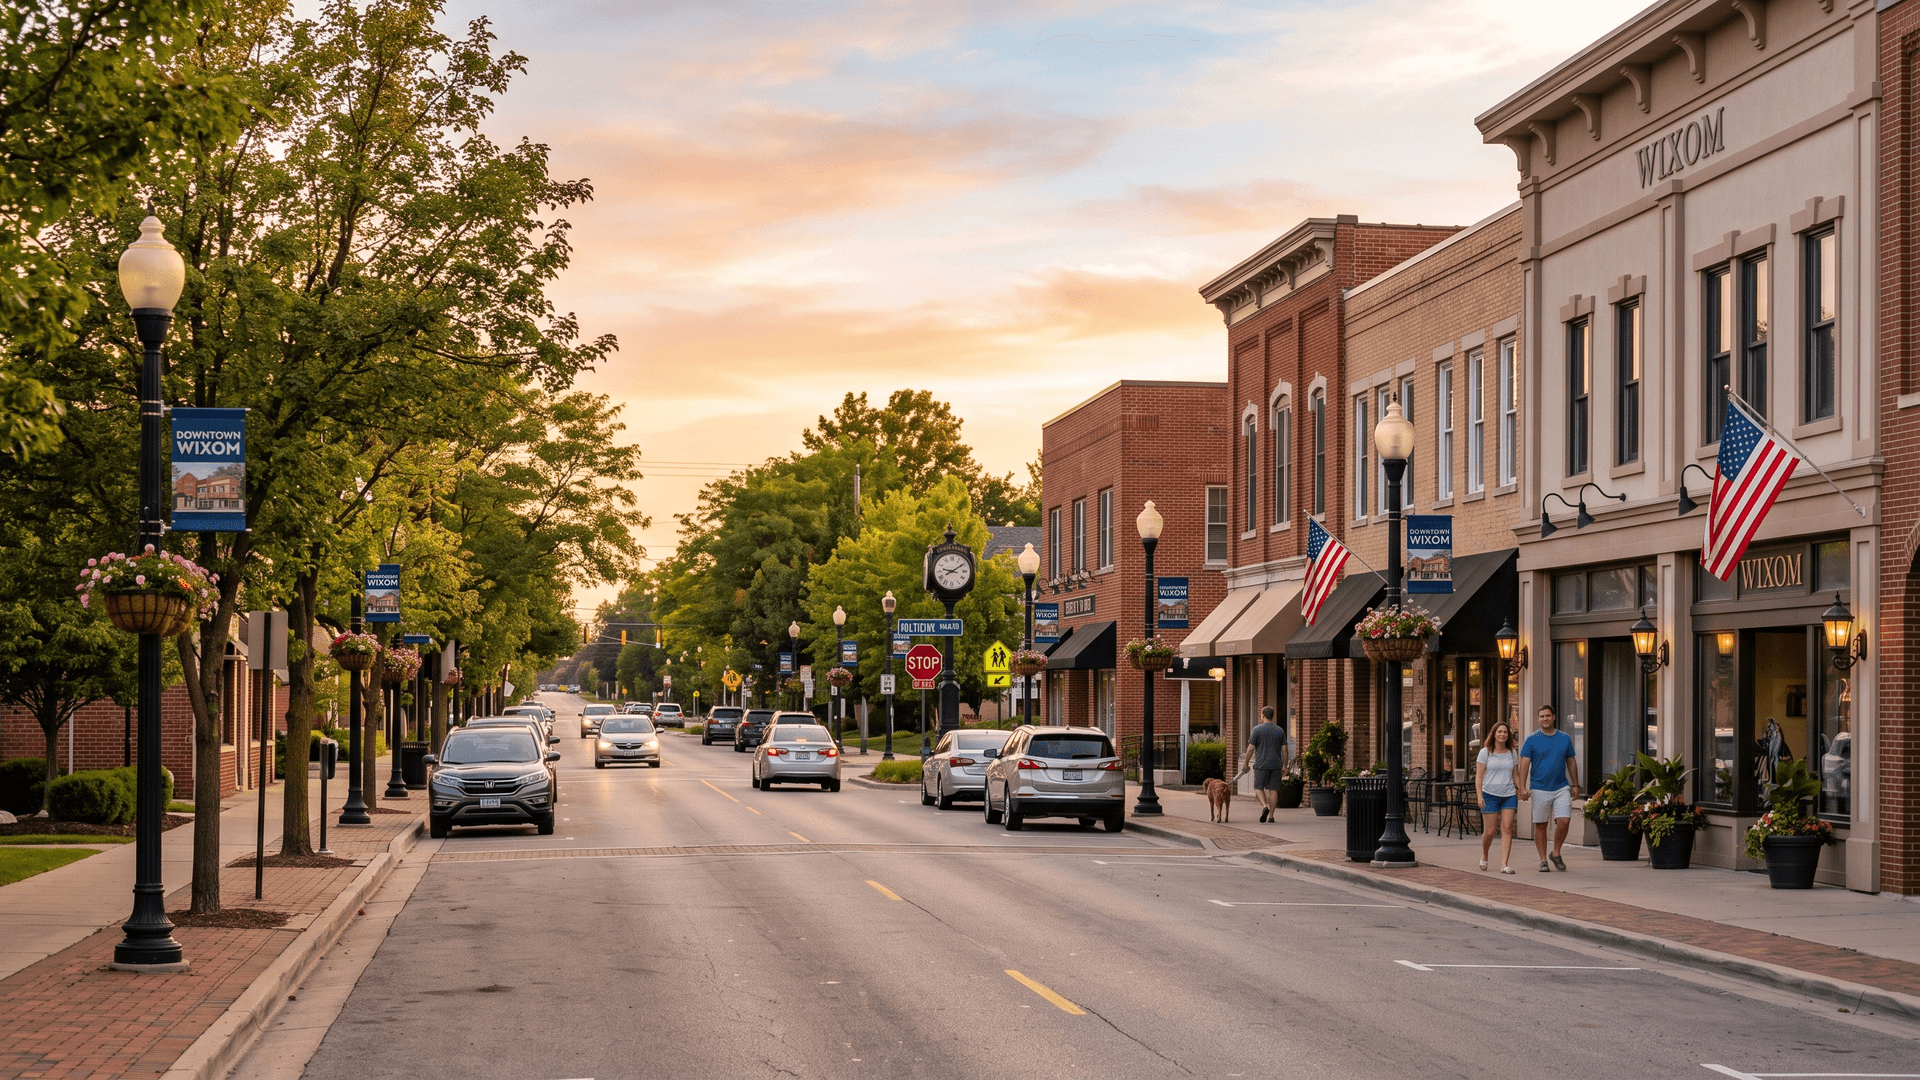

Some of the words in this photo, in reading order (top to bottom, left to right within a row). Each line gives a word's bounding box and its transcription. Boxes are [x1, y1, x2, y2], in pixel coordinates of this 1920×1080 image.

[1635, 106, 1725, 189] WIXOM
[176, 430, 241, 440] DOWNTOWN
[176, 441, 240, 455] WIXOM
[1409, 535, 1450, 545] WIXOM
[1740, 553, 1803, 590] WIXOM
[367, 579, 398, 587] WIXOM
[908, 656, 940, 670] STOP
